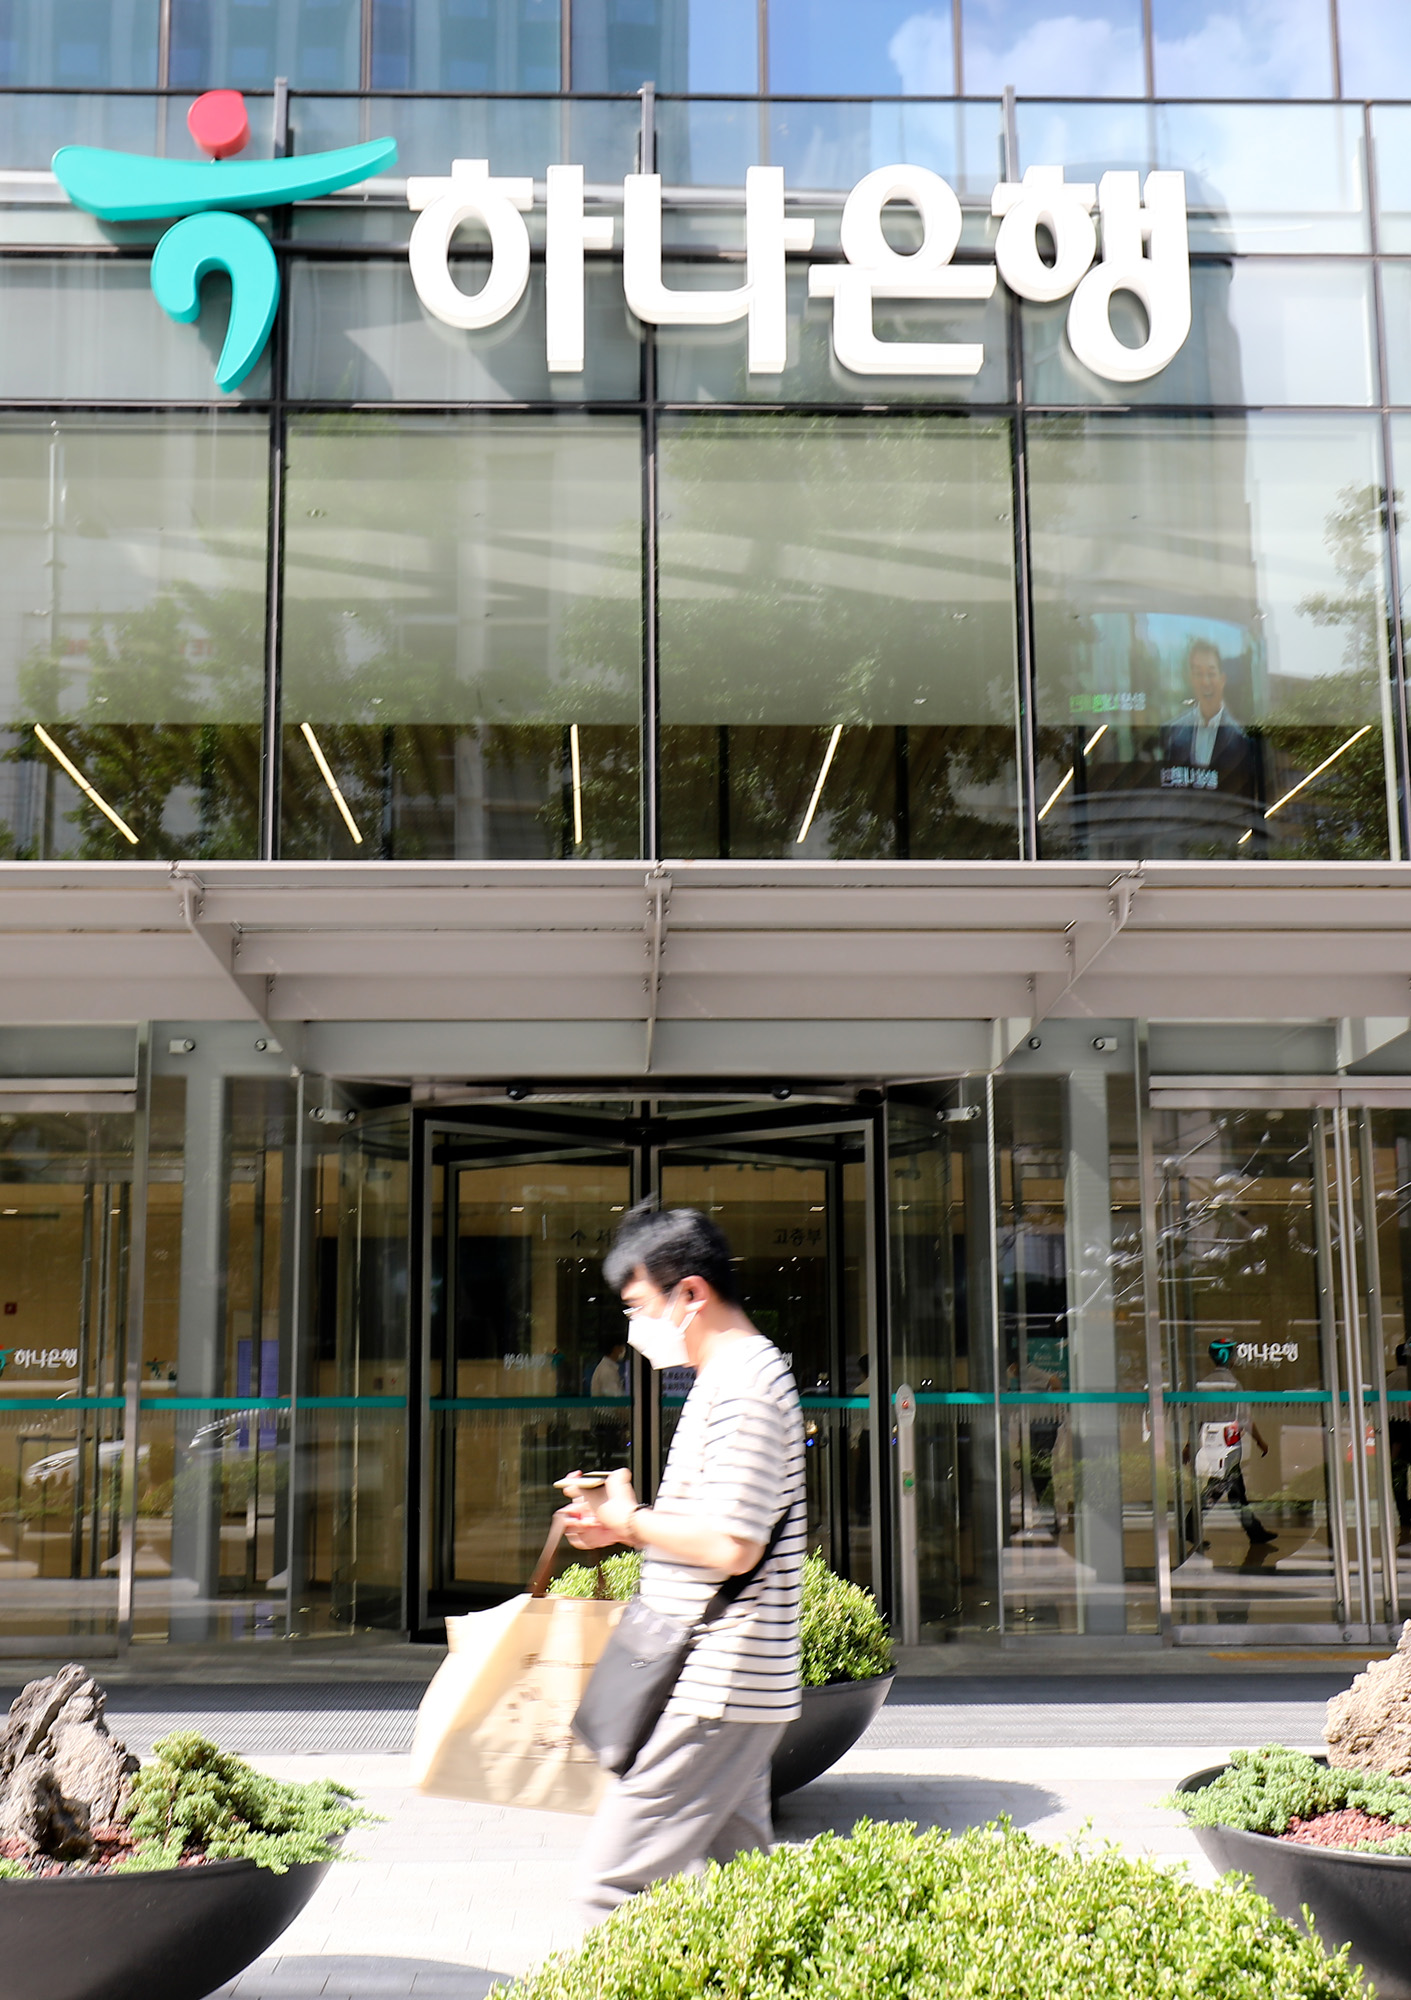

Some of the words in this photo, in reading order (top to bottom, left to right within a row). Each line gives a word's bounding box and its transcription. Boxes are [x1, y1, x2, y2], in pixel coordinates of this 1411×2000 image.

[406, 158, 1192, 382] 하나은행
[14, 1348, 78, 1369] 하나은행
[1236, 1342, 1299, 1362] 하나은행
